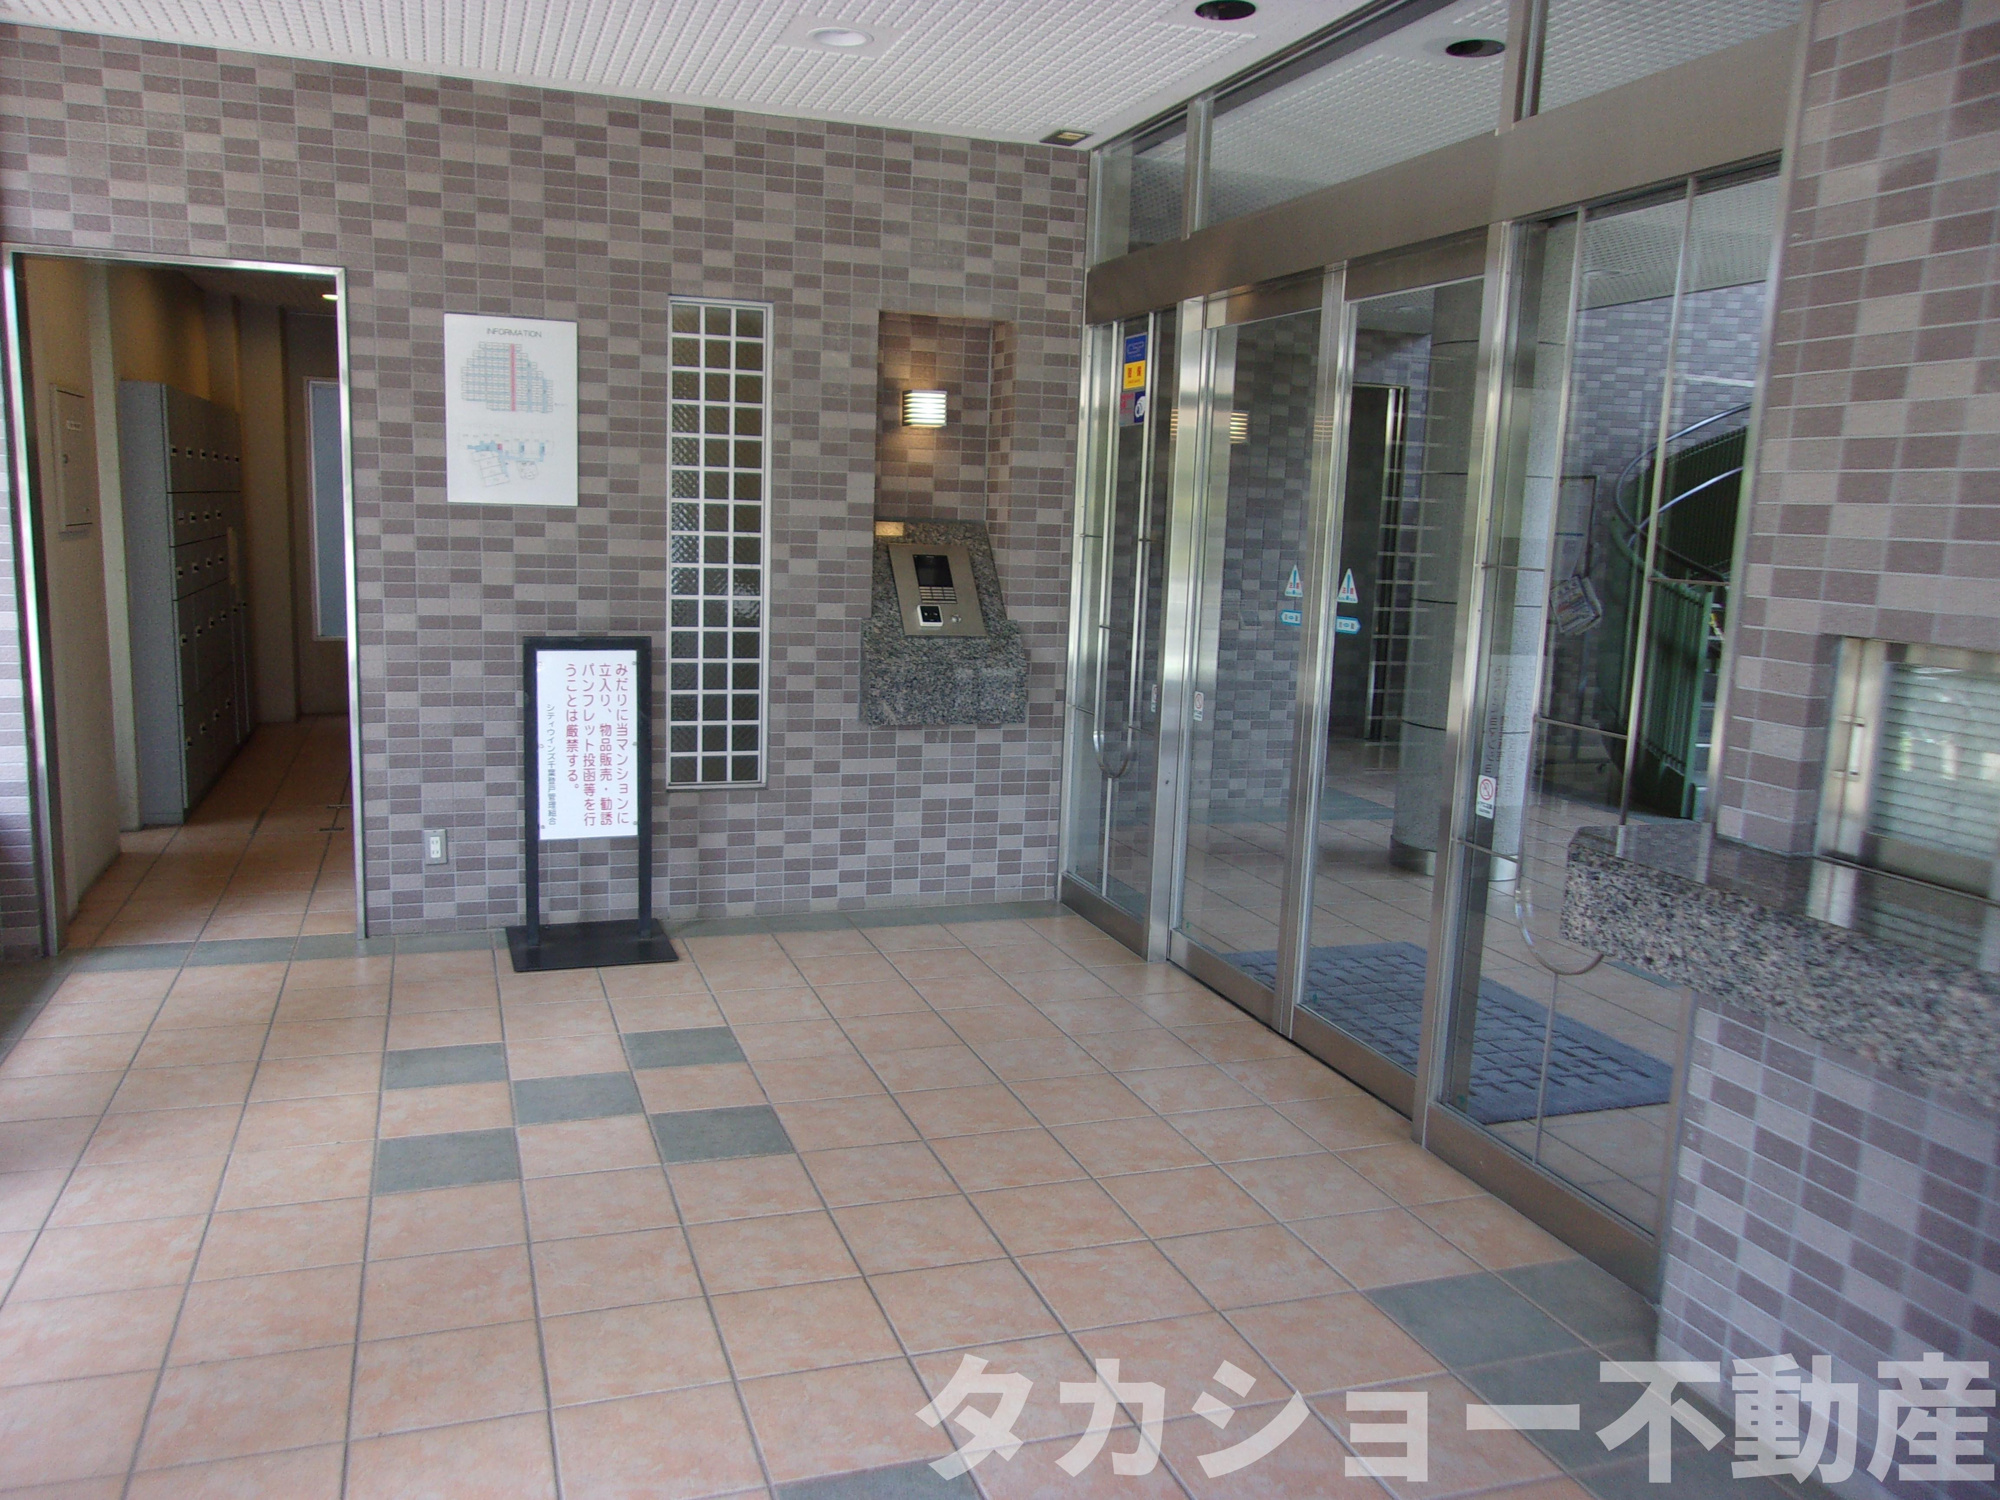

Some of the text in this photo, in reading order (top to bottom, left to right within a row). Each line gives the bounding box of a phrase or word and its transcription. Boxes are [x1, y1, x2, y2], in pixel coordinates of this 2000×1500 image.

[486, 327, 542, 338] INFORMATION
[566, 663, 580, 789] うことは厳禁する。
[582, 662, 596, 827] パンフレット投函等を行
[599, 662, 613, 826] 立入り、物品販売・勧誘
[615, 663, 629, 825] みだりに当マンションに
